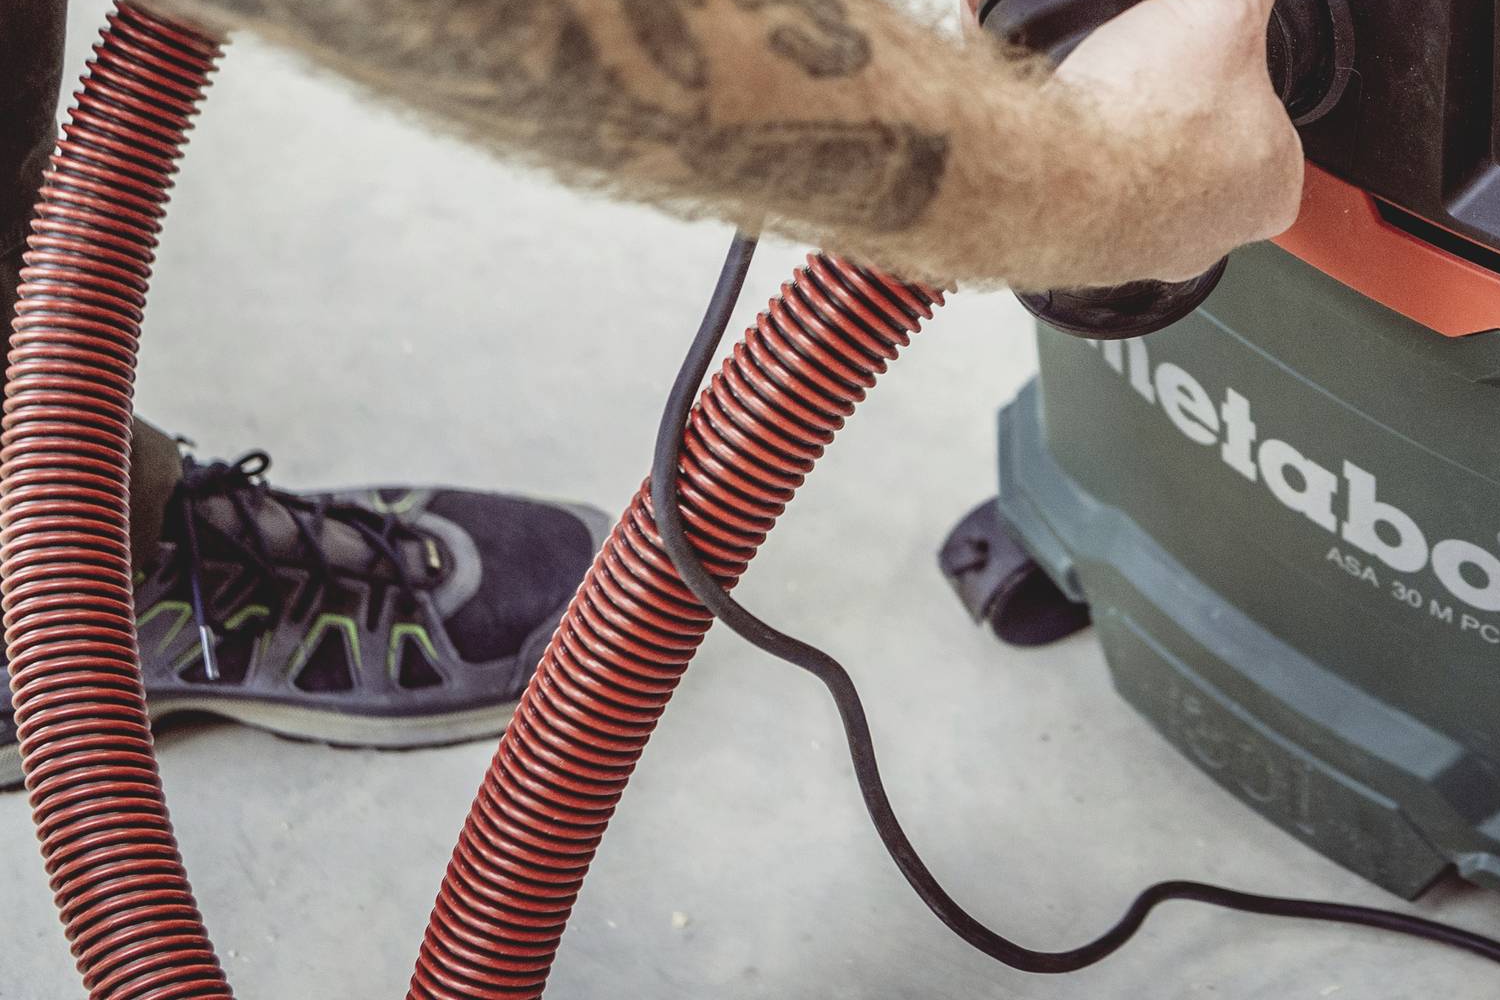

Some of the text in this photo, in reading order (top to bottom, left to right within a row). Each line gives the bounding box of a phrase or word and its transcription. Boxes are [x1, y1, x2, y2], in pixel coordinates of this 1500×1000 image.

[1326, 547, 1500, 644] ASA 30 M PC
